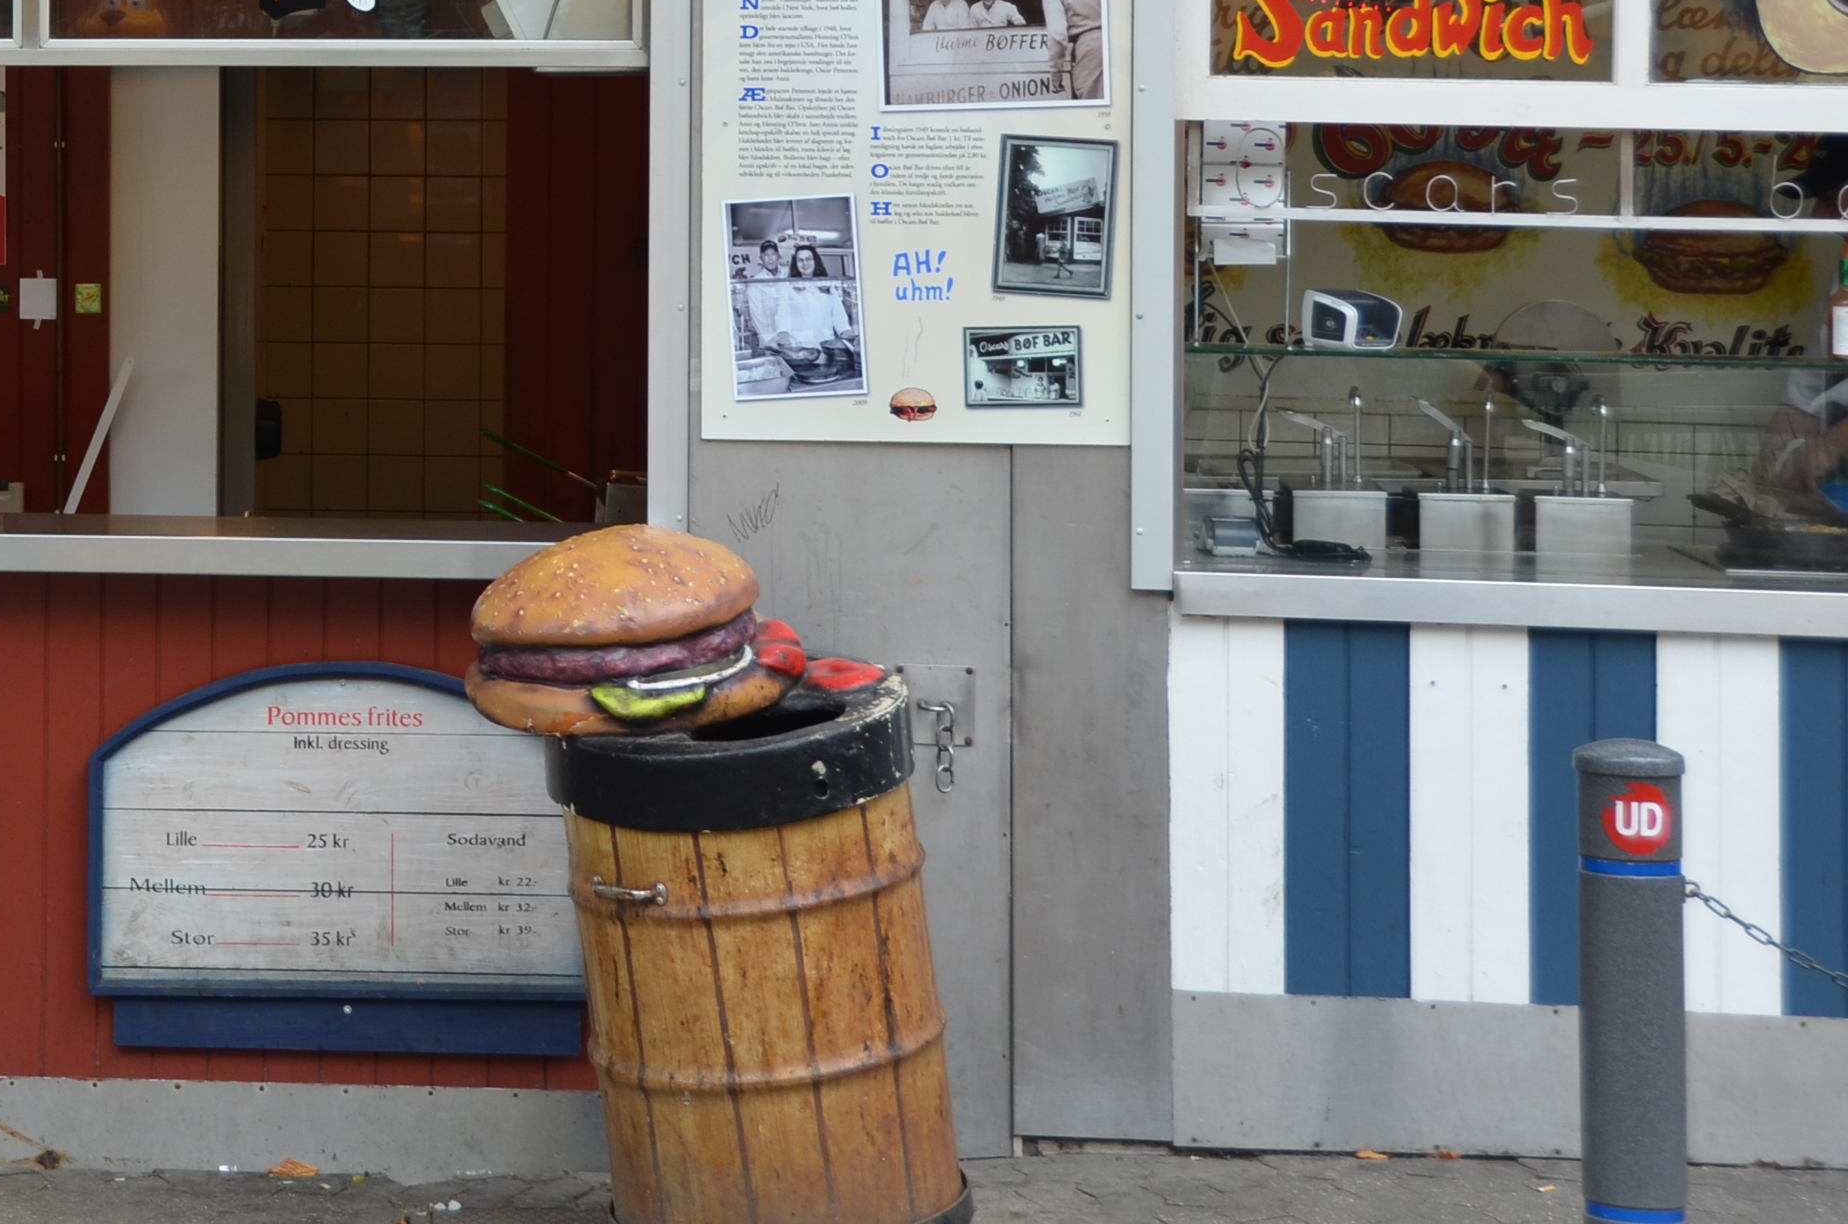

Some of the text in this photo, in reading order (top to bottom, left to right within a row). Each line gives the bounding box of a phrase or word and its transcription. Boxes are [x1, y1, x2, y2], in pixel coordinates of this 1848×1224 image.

[985, 33, 1049, 52] BØFFER
[893, 250, 948, 277] AH!
[895, 278, 954, 302] uhm!
[1014, 337, 1039, 351] BØF
[1043, 331, 1072, 347] BAR
[266, 706, 424, 728] Pommes frites
[293, 735, 390, 755] Inkl. dressing
[1615, 800, 1663, 837] UD
[166, 831, 350, 849] Lille 25 kr
[447, 833, 527, 847] Sodavand
[130, 877, 354, 899] Mellem 30 kr
[445, 876, 510, 887] Lille kr
[444, 902, 510, 912] Mellem kr
[171, 929, 353, 947] Stor 35 kr
[445, 925, 510, 937] Stor kr
